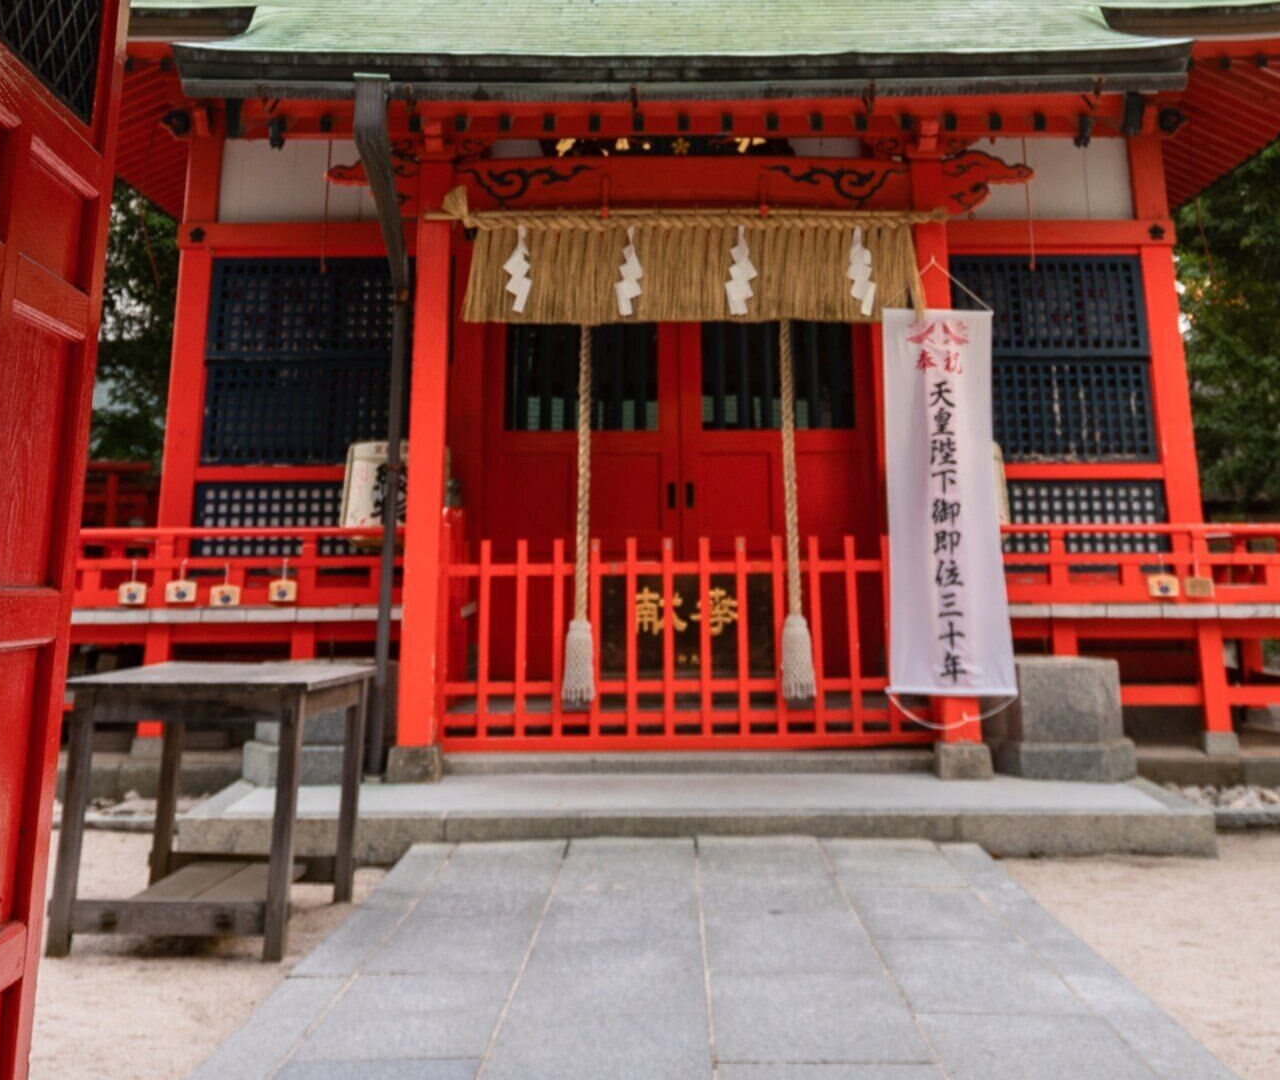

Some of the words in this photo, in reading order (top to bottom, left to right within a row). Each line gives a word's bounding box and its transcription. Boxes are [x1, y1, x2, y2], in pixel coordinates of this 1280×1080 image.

[915, 349, 964, 375] 奉祝
[928, 381, 967, 683] 天皇陛下御即位三十年
